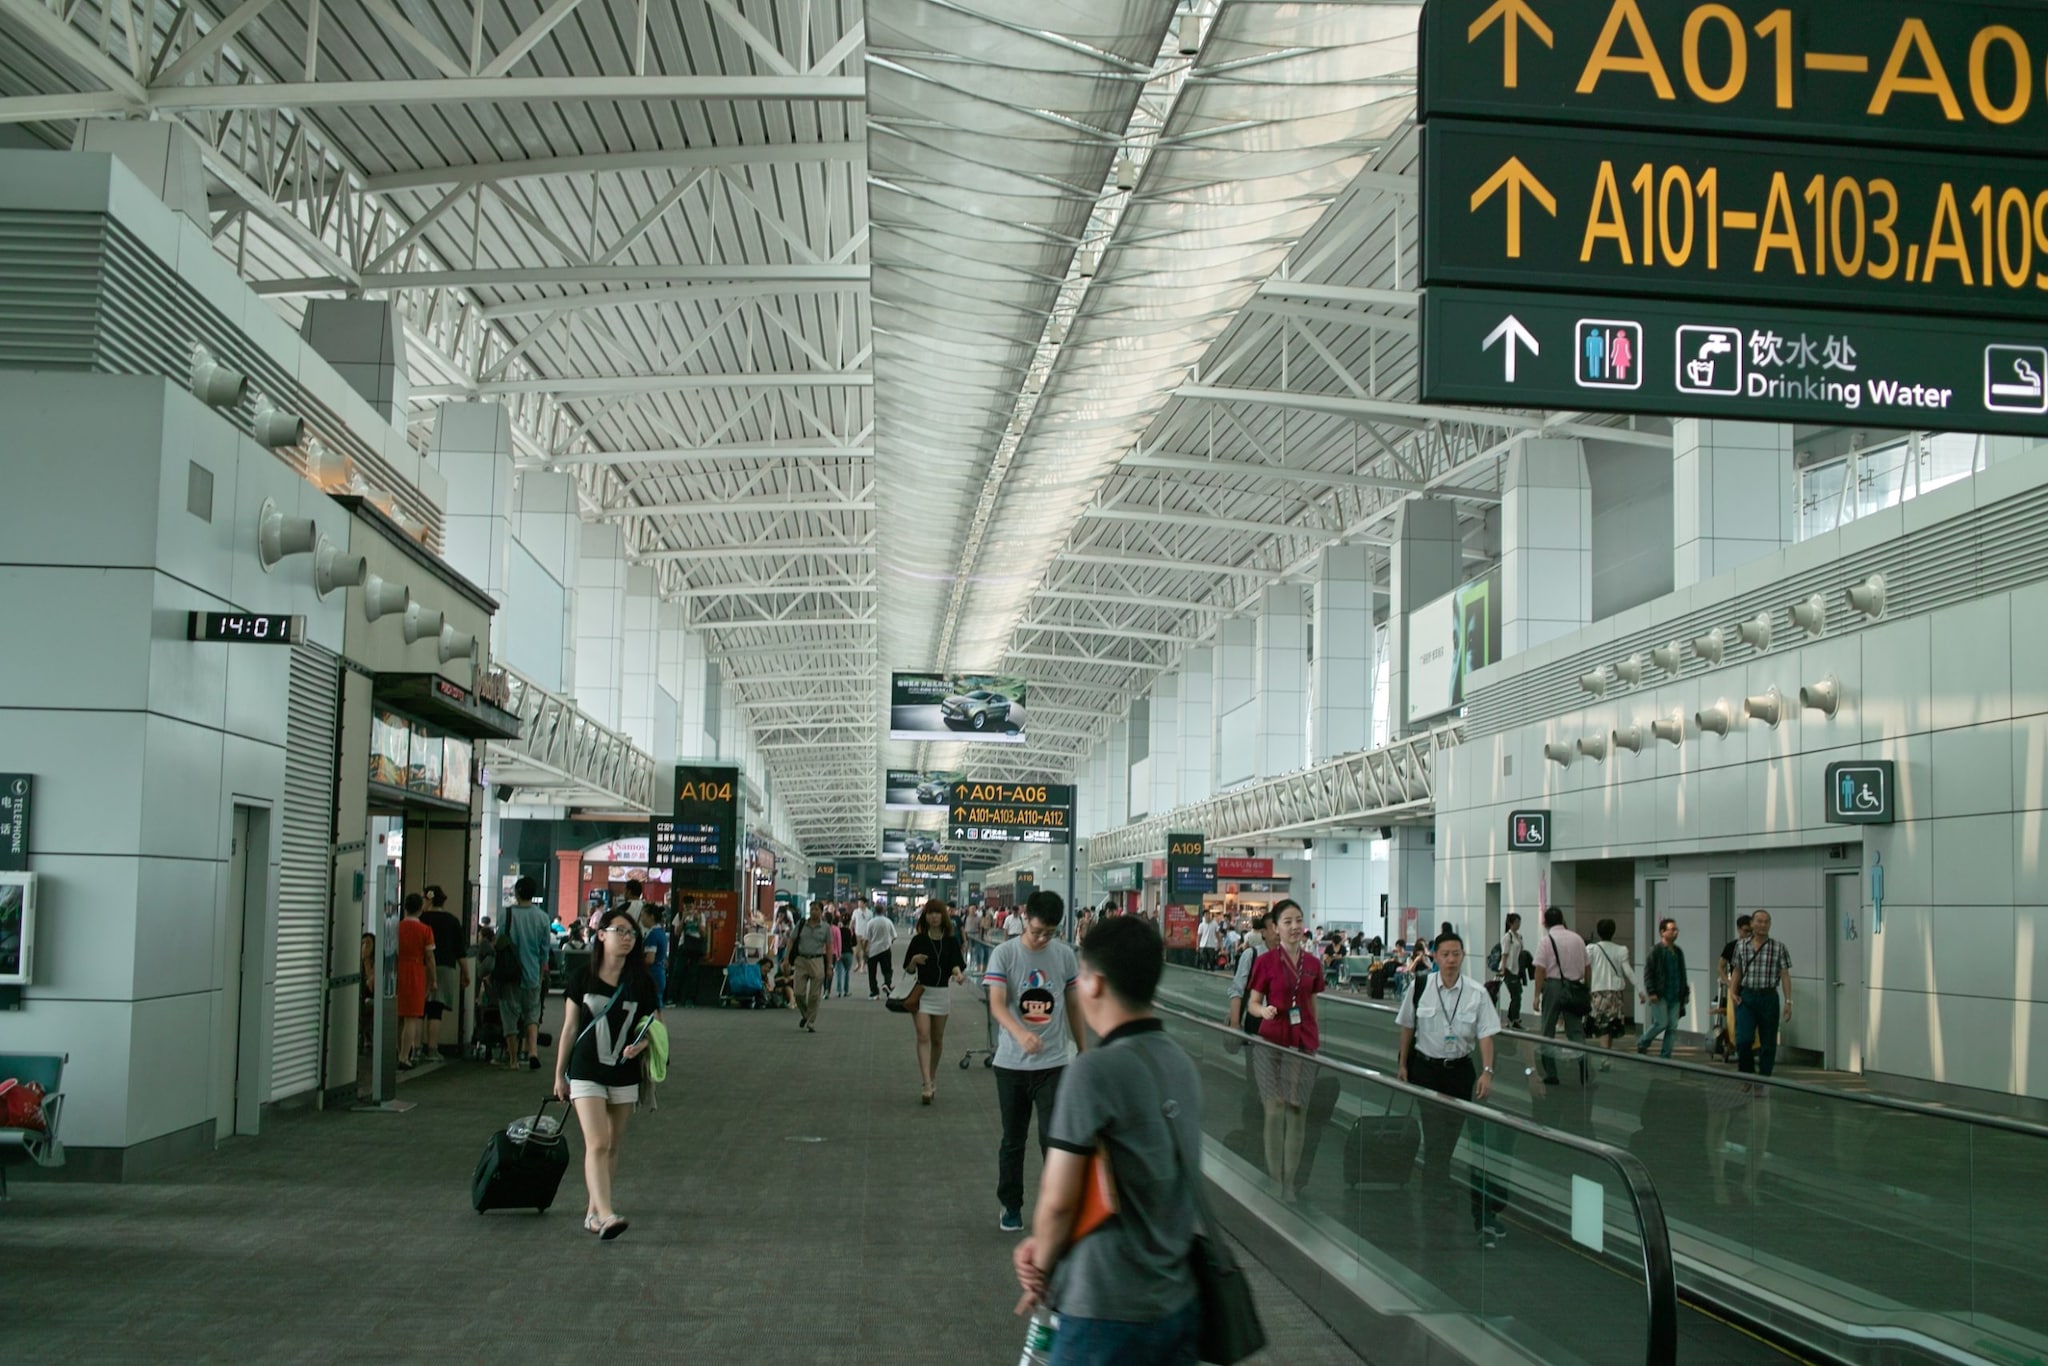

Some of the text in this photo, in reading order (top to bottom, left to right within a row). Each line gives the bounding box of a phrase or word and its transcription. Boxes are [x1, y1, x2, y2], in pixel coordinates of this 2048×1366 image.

[1575, 0, 2048, 124] A01-A0
[1748, 329, 1858, 372] 饮水处
[1747, 372, 1952, 409] Drinking Water
[220, 617, 287, 638] 14:01
[680, 781, 732, 802] A104
[970, 784, 1047, 803] A01-A06
[11, 797, 23, 854] TELEPHONE
[1171, 842, 1202, 855] A109
